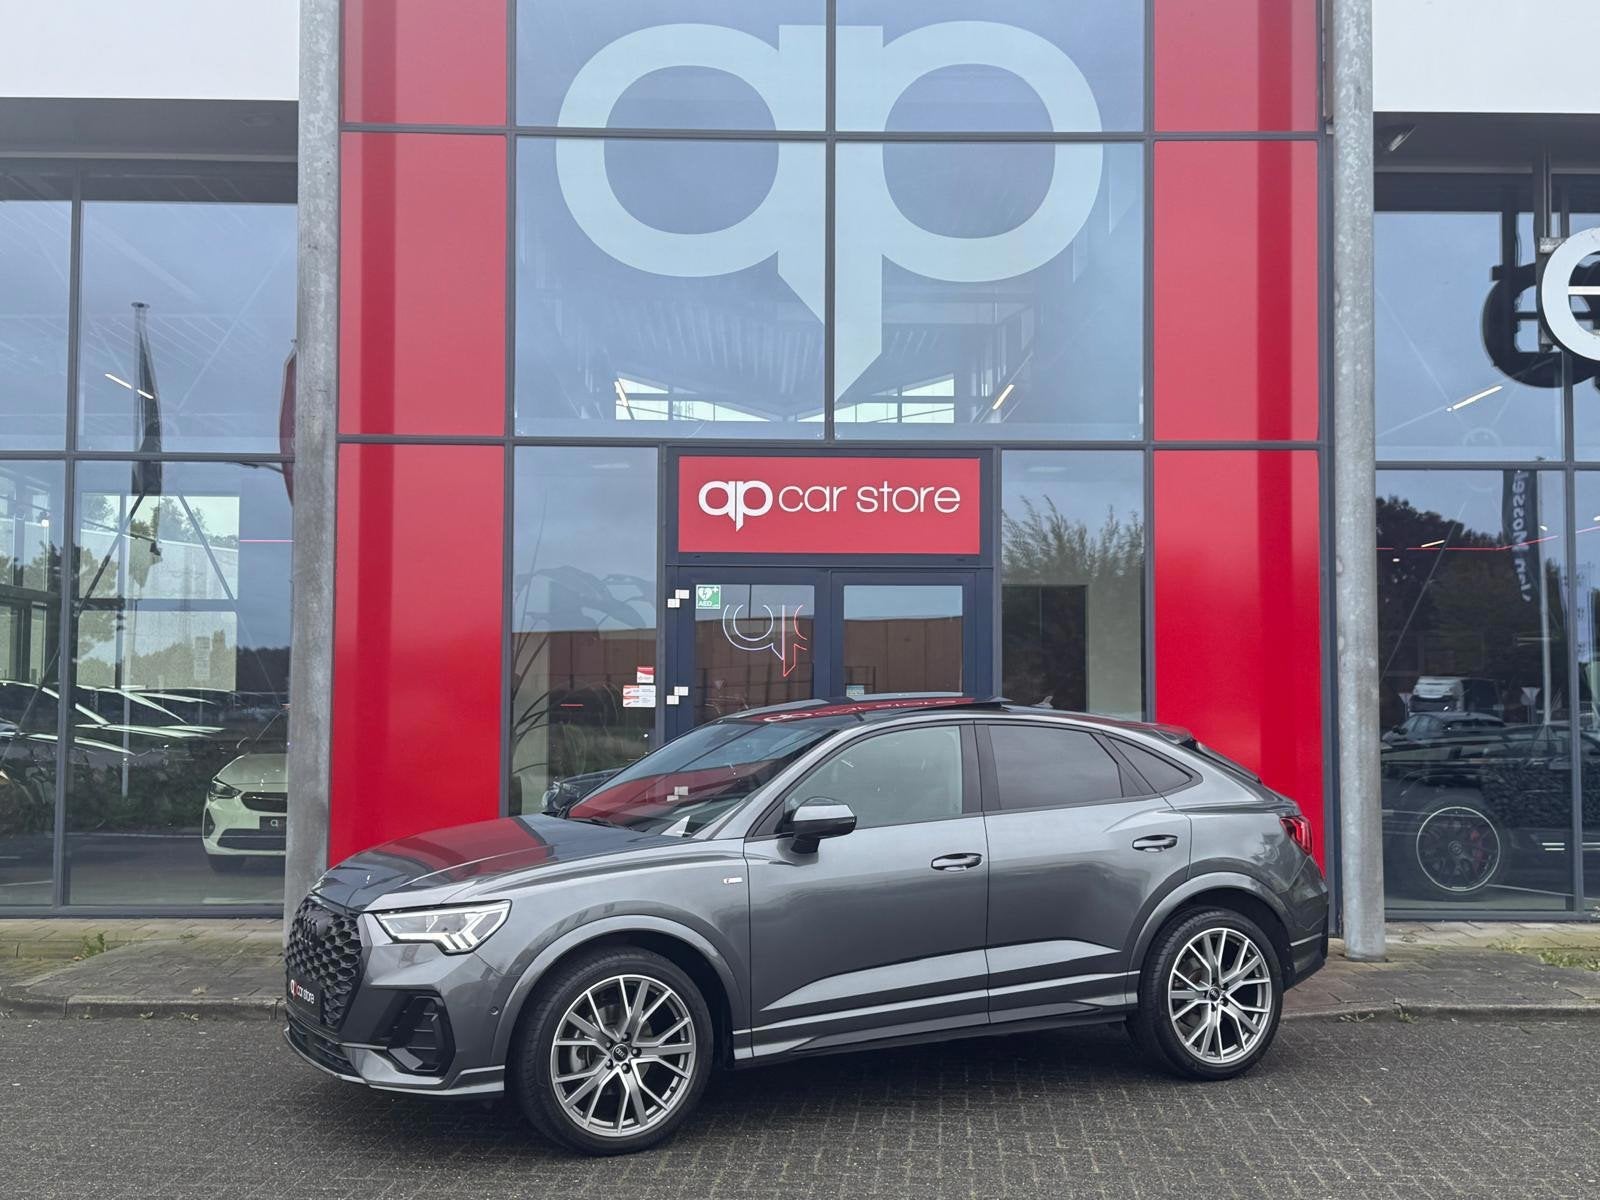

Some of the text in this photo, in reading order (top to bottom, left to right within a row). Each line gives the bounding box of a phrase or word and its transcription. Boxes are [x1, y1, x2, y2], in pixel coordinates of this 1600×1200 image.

[698, 480, 961, 532] ap car store
